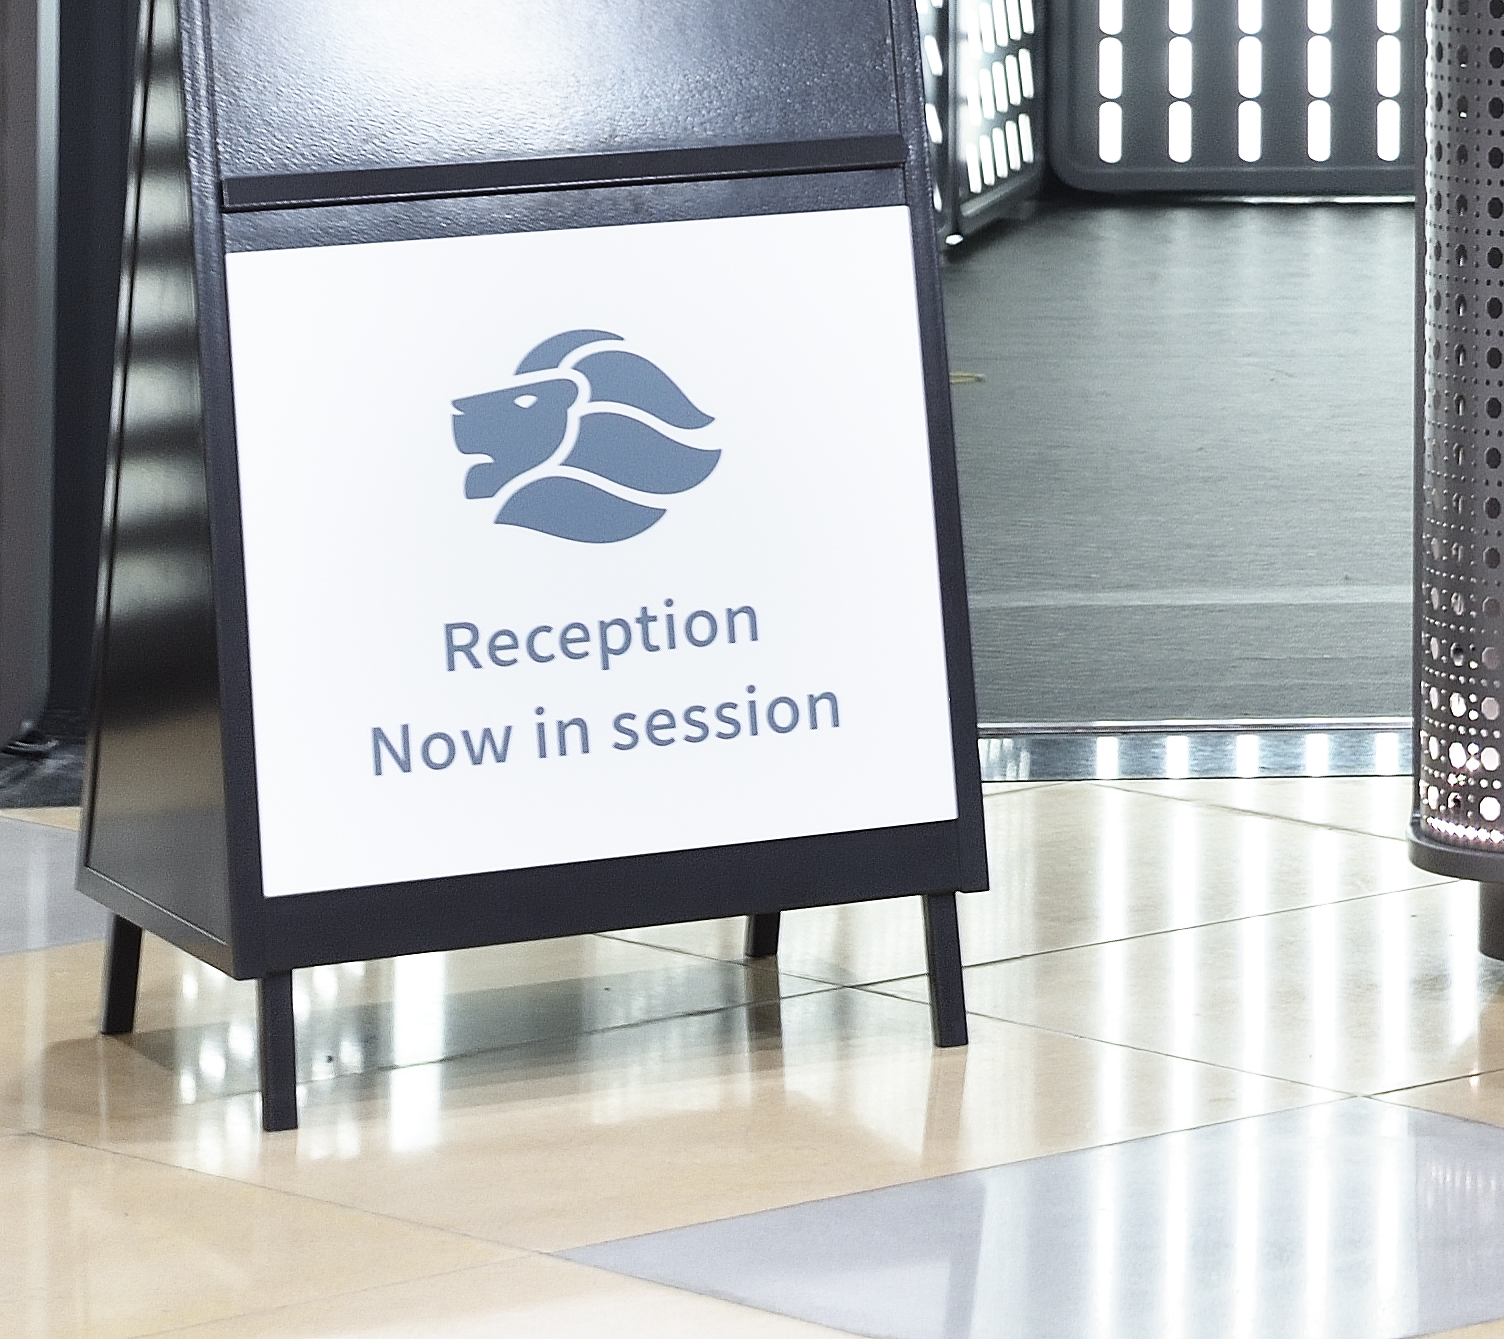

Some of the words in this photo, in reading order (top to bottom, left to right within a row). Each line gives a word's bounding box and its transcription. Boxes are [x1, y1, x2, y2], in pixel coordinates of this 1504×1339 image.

[444, 598, 759, 671] Reception
[371, 723, 513, 776] Now
[535, 707, 590, 759] in
[612, 684, 840, 751] session
